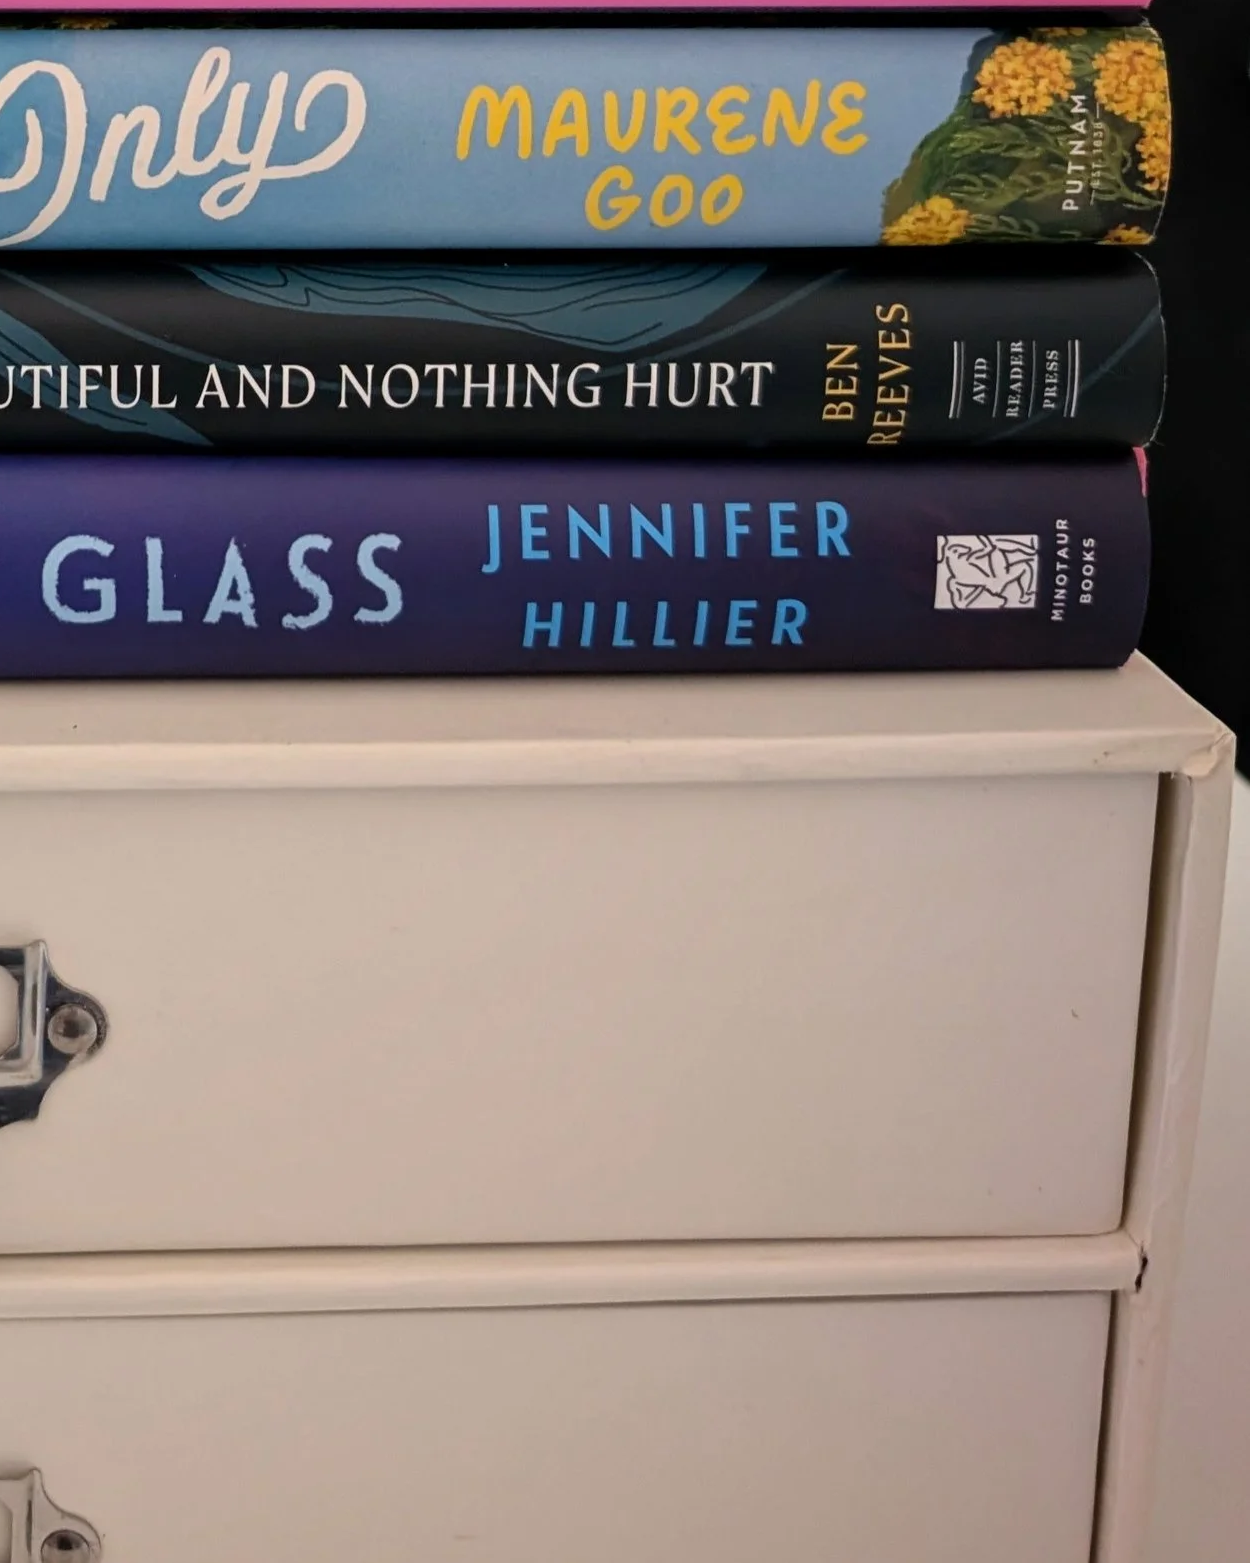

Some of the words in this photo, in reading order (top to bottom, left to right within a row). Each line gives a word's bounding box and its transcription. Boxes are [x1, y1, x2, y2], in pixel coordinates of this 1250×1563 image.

[456, 79, 869, 161] MAURENE
[1062, 94, 1089, 212] PUTNAM
[584, 164, 744, 231] GOO
[195, 362, 317, 410] AND
[337, 361, 602, 408] NOTHING
[623, 360, 775, 408] HURT
[822, 342, 858, 421] BEN
[866, 302, 913, 446] REEVES
[972, 357, 989, 405] AVID
[1005, 340, 1024, 418] READER
[1042, 349, 1060, 410] PRESS
[481, 500, 852, 574] JENNIFER
[1051, 518, 1070, 621] MINOTAUR
[1079, 538, 1095, 604] BOOKS
[41, 532, 403, 630] GLASS
[521, 598, 809, 648] HILLIER
